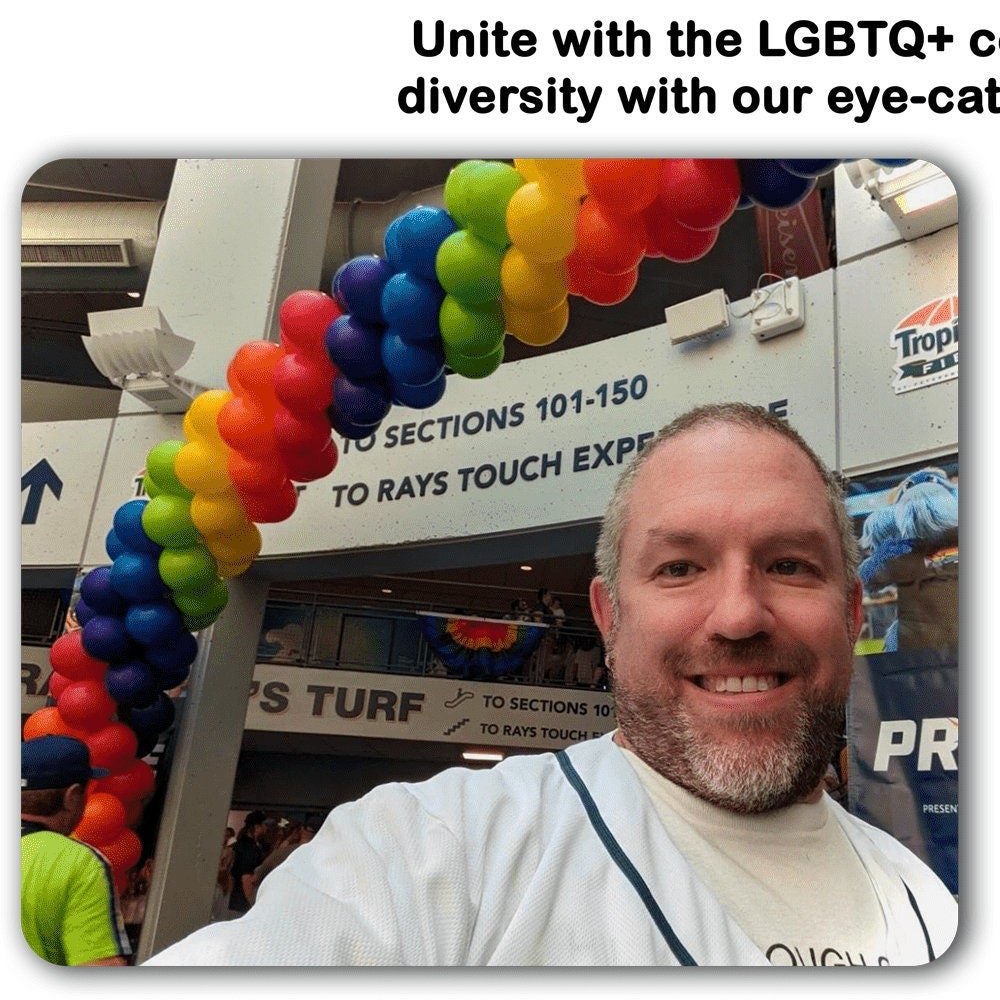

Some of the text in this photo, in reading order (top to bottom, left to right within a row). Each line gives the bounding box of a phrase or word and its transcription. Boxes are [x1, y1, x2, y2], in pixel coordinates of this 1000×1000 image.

[384, 402, 524, 448] SECTIONS
[536, 374, 648, 421] 101-150
[332, 483, 369, 508] TO
[377, 471, 448, 502] RAYS
[458, 451, 561, 491] TOUCH
[307, 684, 426, 722] TURF
[482, 695, 615, 717] TO SECTIONS 10
[480, 723, 499, 735] TO
[503, 725, 537, 737] RAYS
[541, 727, 588, 741] TOUCH
[923, 804, 958, 814] PRESEN
